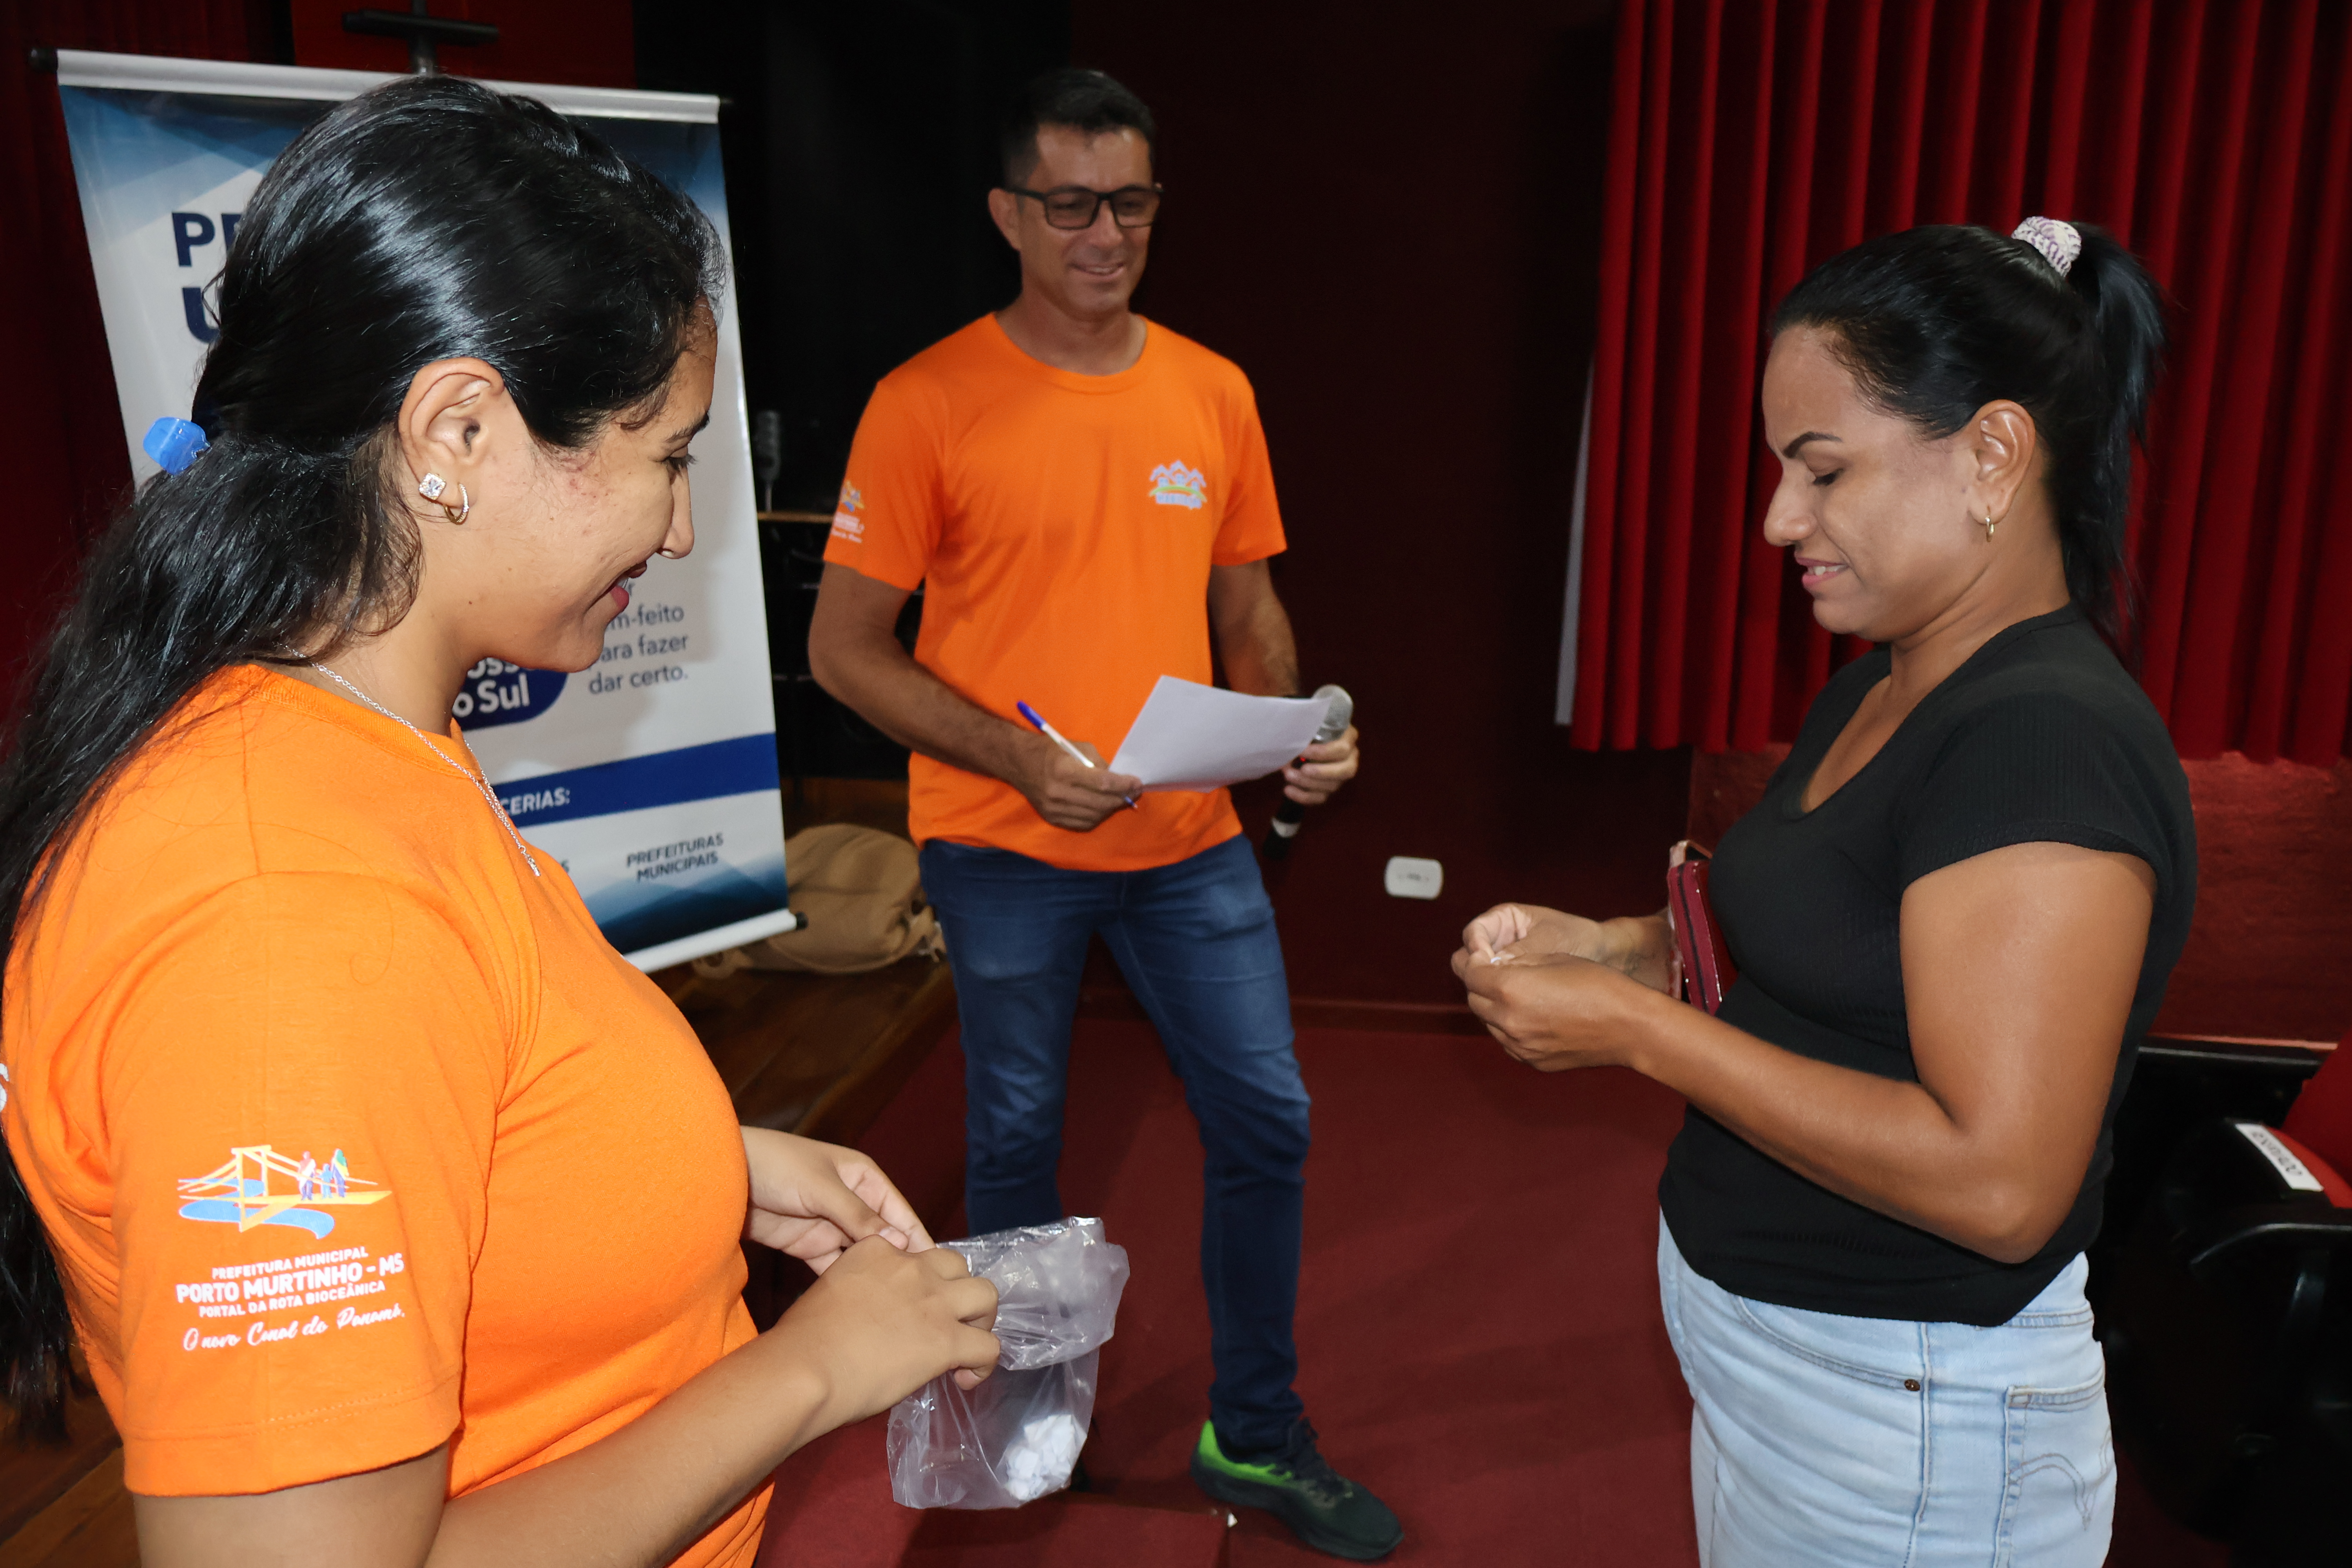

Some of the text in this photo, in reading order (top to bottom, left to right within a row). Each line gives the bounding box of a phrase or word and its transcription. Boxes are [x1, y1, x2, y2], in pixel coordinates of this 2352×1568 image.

[600, 632, 688, 663] ara fazer
[476, 672, 530, 713] Sul
[589, 665, 688, 695] dar certo.
[627, 831, 724, 867] PREFEITURAS
[636, 850, 719, 882] MUNICIPAIS
[176, 1281, 240, 1303] PORTO
[243, 1262, 363, 1300] MURTINHO
[379, 1252, 405, 1276] MS
[212, 1246, 368, 1280] PREFEITURA MUNICIPAL
[199, 1279, 386, 1318] PORTAL DA ROTA BIOCEÂNICA
[183, 1327, 199, 1351] O
[200, 1334, 242, 1348] novo
[247, 1319, 298, 1346] Canal
[301, 1315, 329, 1336] do
